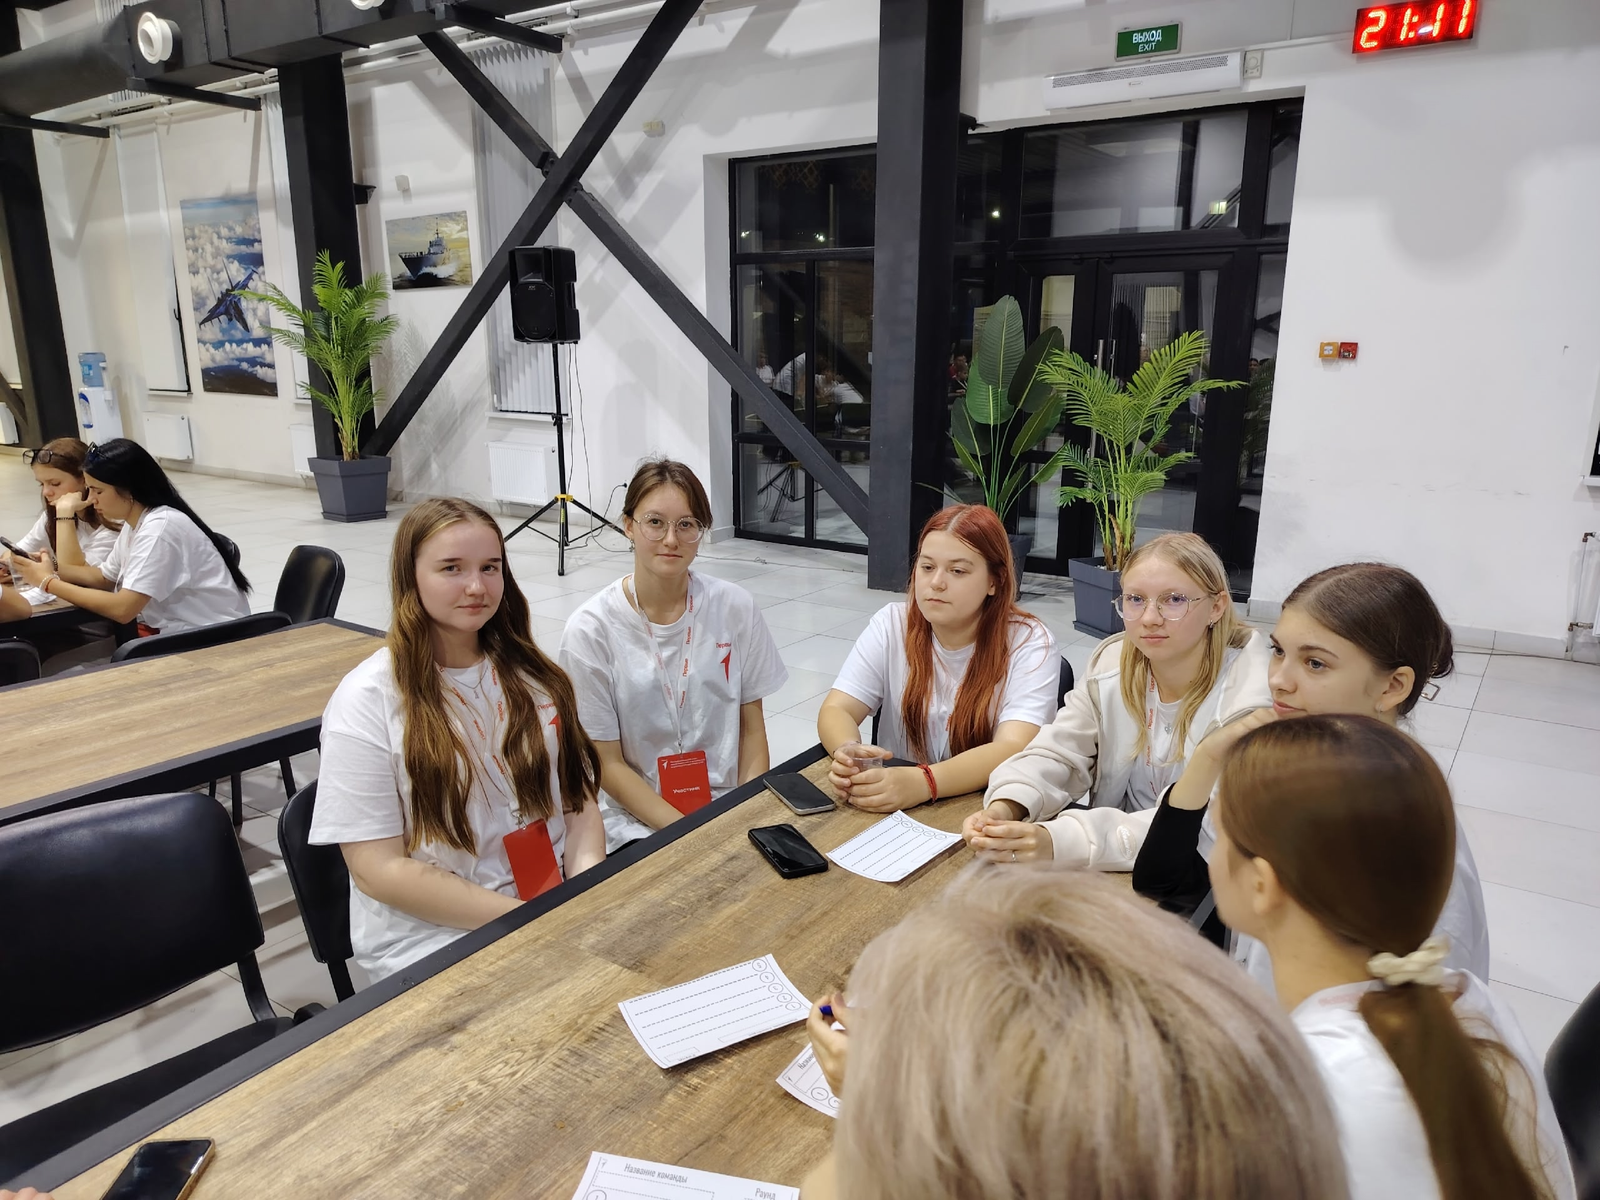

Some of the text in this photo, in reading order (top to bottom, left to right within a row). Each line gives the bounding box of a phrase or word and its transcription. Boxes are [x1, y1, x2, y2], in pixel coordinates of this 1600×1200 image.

[1132, 29, 1162, 44] ВЫХОД
[1138, 42, 1157, 52] EXIT
[624, 1163, 688, 1184] Название команды
[755, 1187, 777, 1200] Раунд
